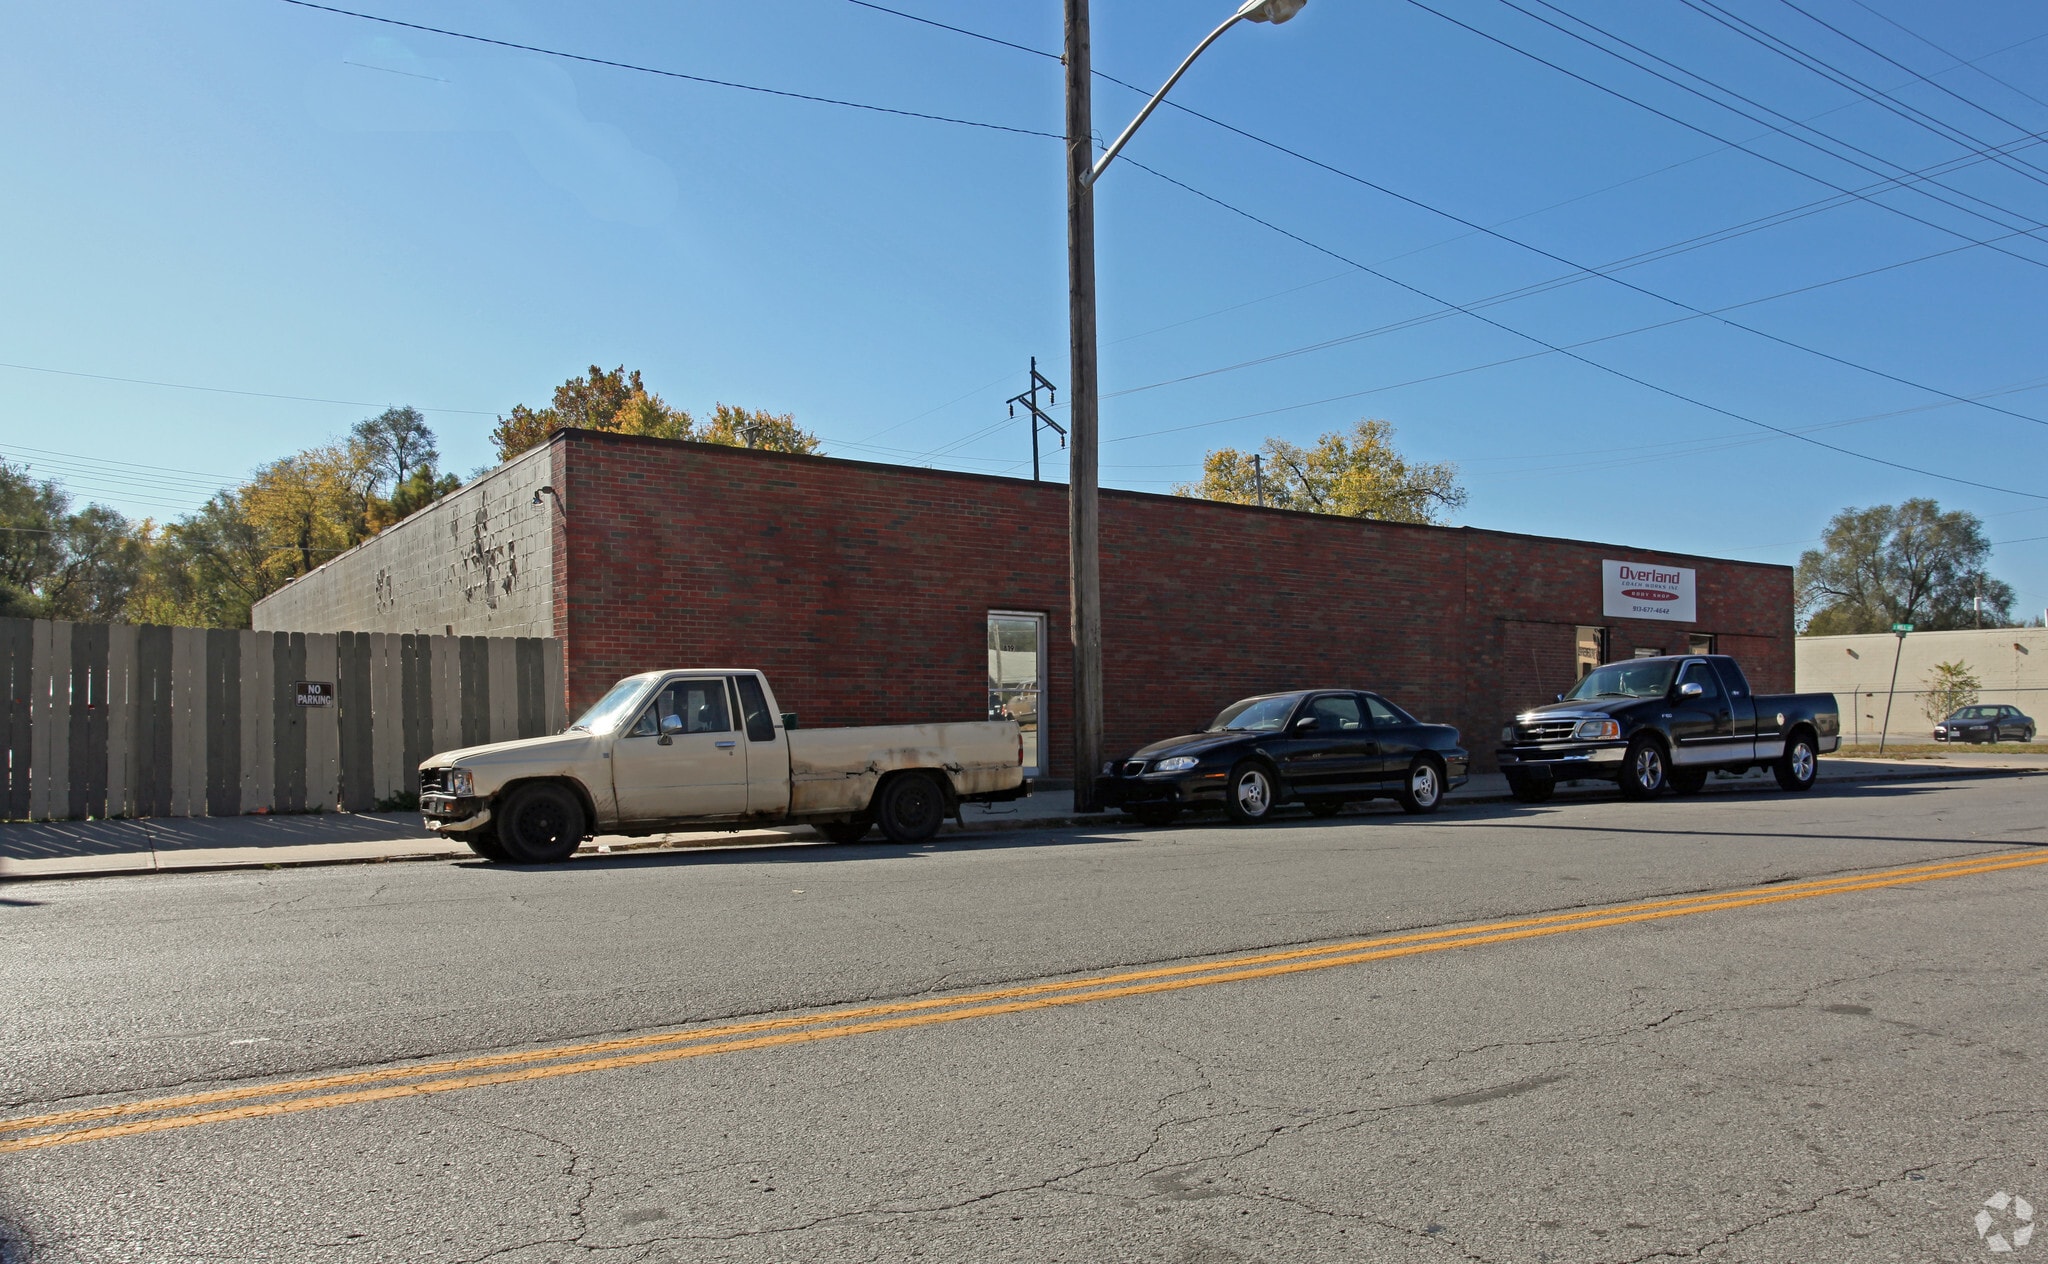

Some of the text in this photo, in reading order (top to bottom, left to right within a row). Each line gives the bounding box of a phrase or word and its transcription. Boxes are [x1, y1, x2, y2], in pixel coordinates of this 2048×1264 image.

[1619, 566, 1680, 584] Overland
[307, 684, 321, 695] NO
[297, 694, 331, 705] PARKING
